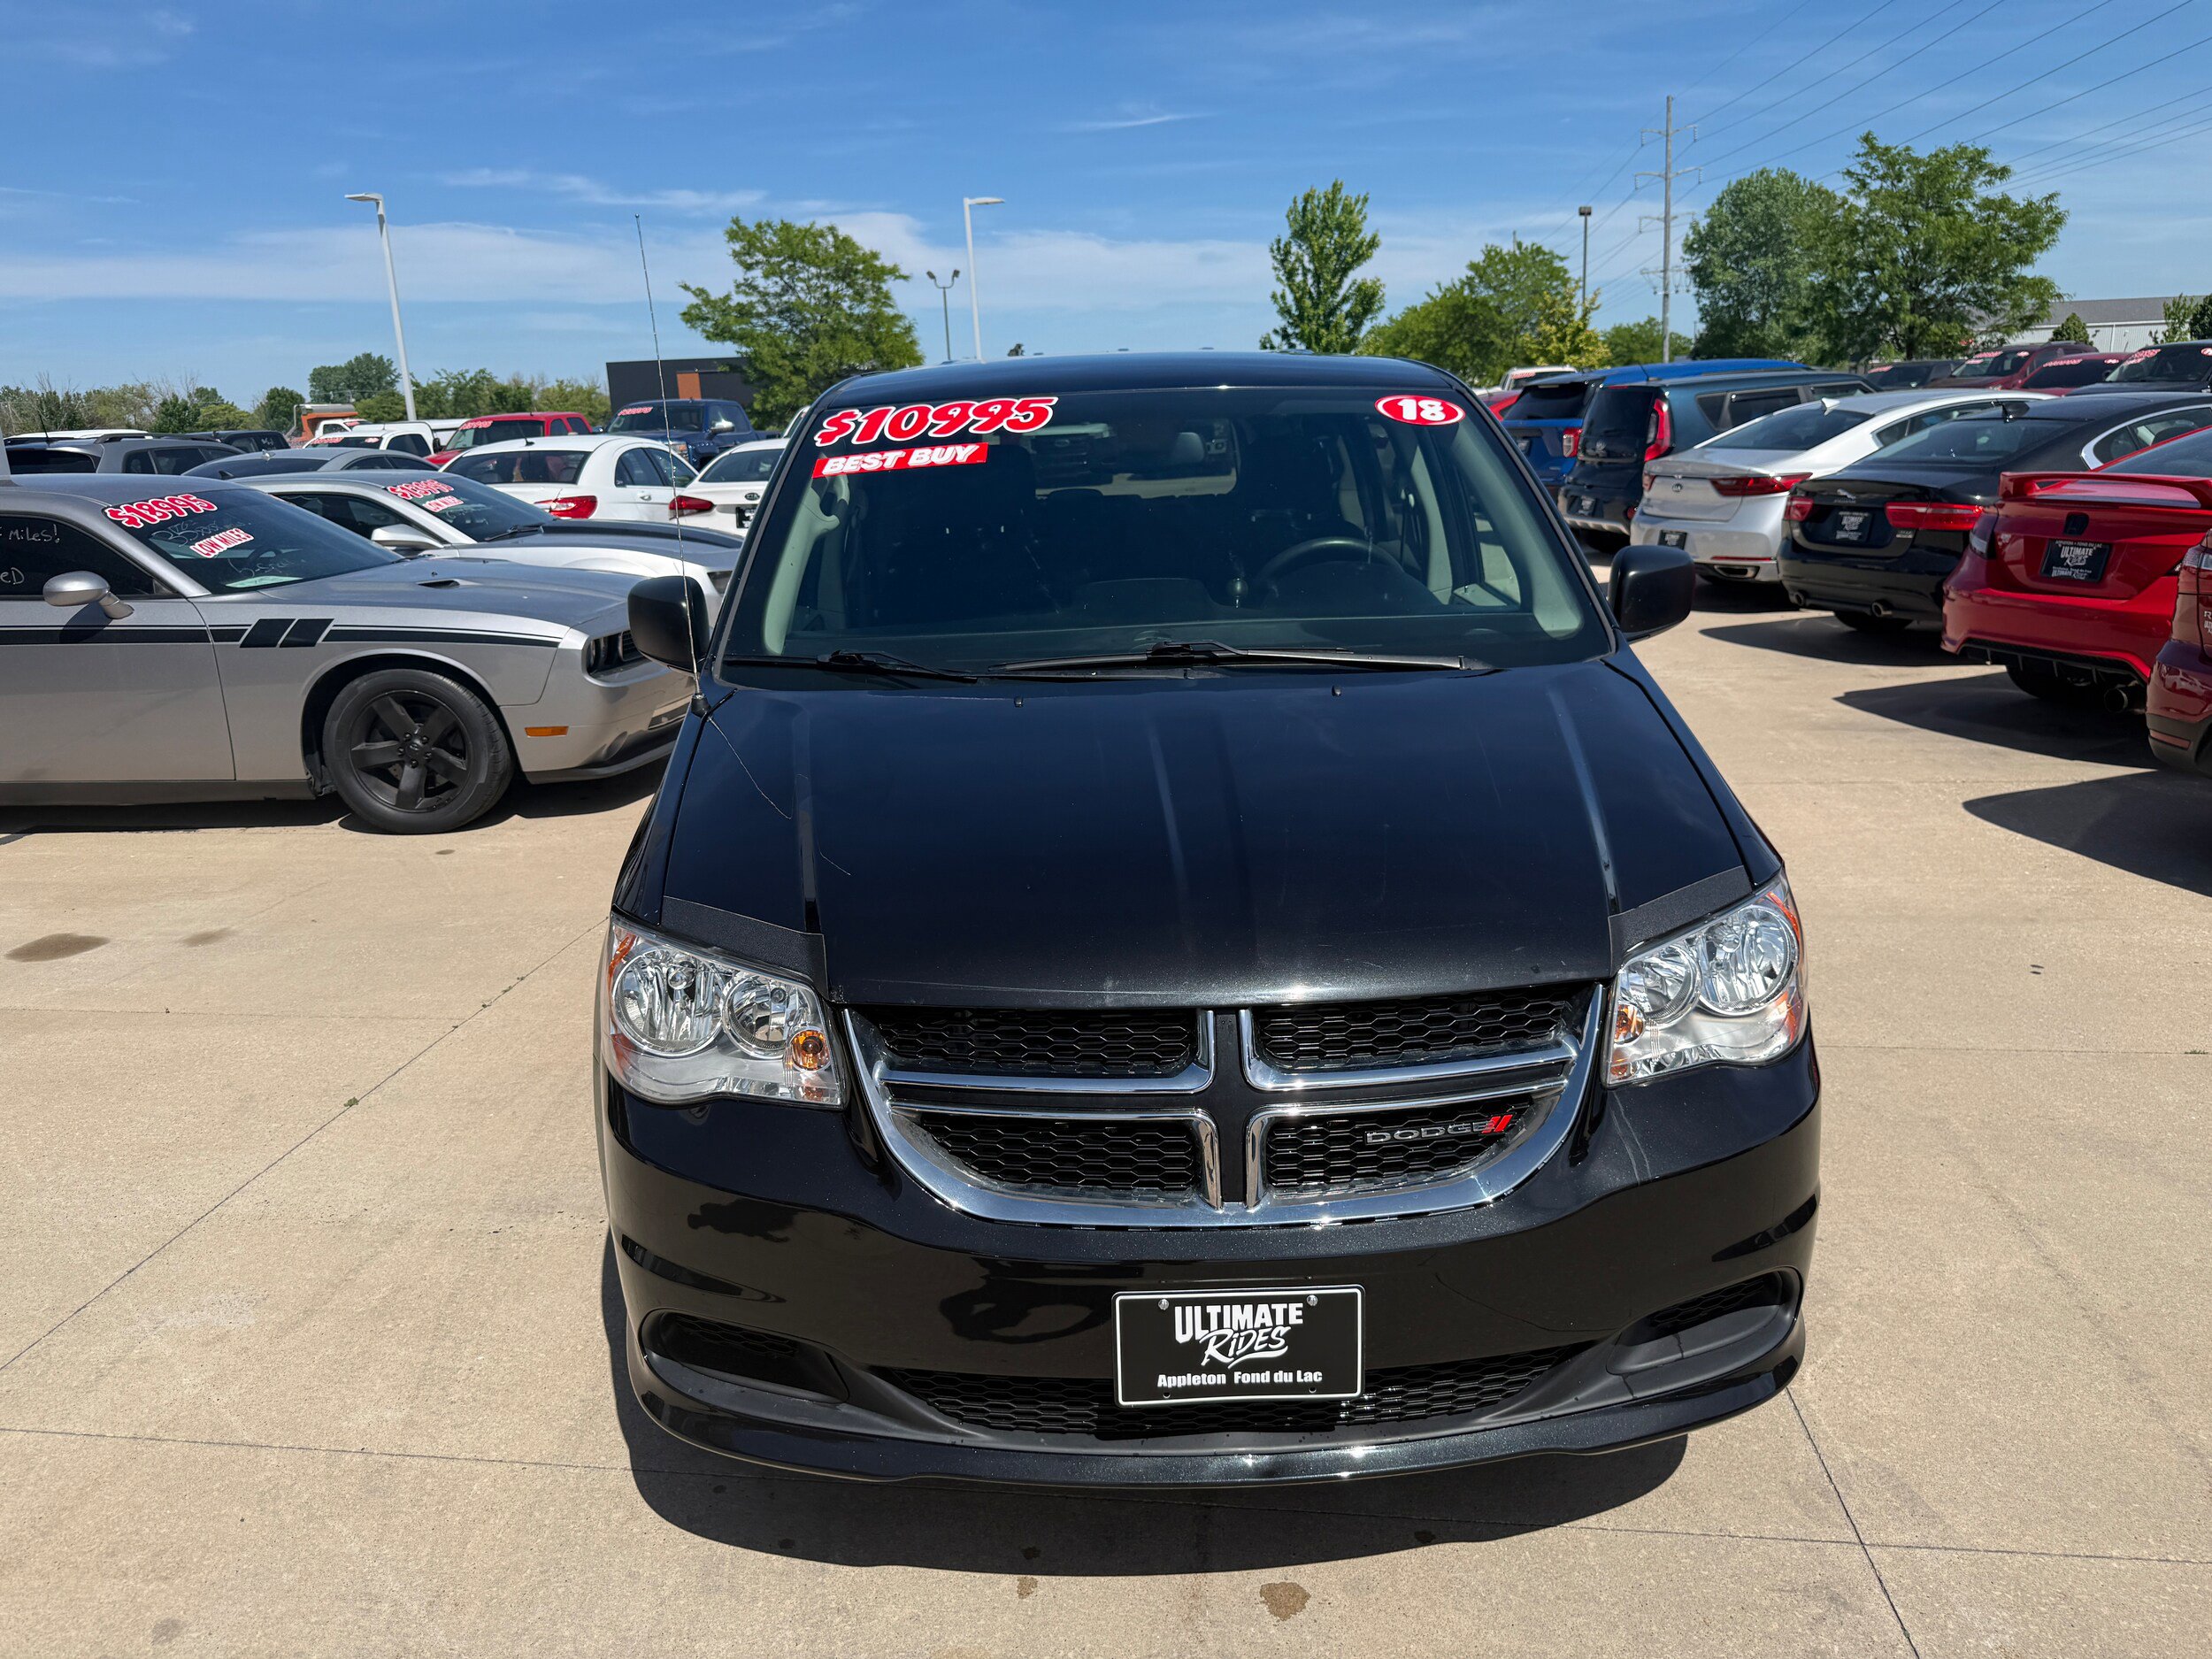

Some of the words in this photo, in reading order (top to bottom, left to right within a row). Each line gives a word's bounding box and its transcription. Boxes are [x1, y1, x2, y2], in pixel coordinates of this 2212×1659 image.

[813, 396, 1059, 447] $10995
[1396, 398, 1447, 422] 18
[821, 450, 906, 475] BEST
[907, 444, 980, 466] BUY
[104, 493, 219, 529] $18995
[189, 534, 226, 558] LOW
[211, 528, 254, 549] MILES
[2061, 546, 2093, 558] ULTIMATE
[1365, 1120, 1494, 1144] DODGE
[1174, 1302, 1303, 1345] ULTIMATE
[1156, 1372, 1226, 1388] Appleton
[1233, 1371, 1271, 1384] Fond
[1273, 1371, 1290, 1383] du
[1296, 1370, 1323, 1383] Lac
